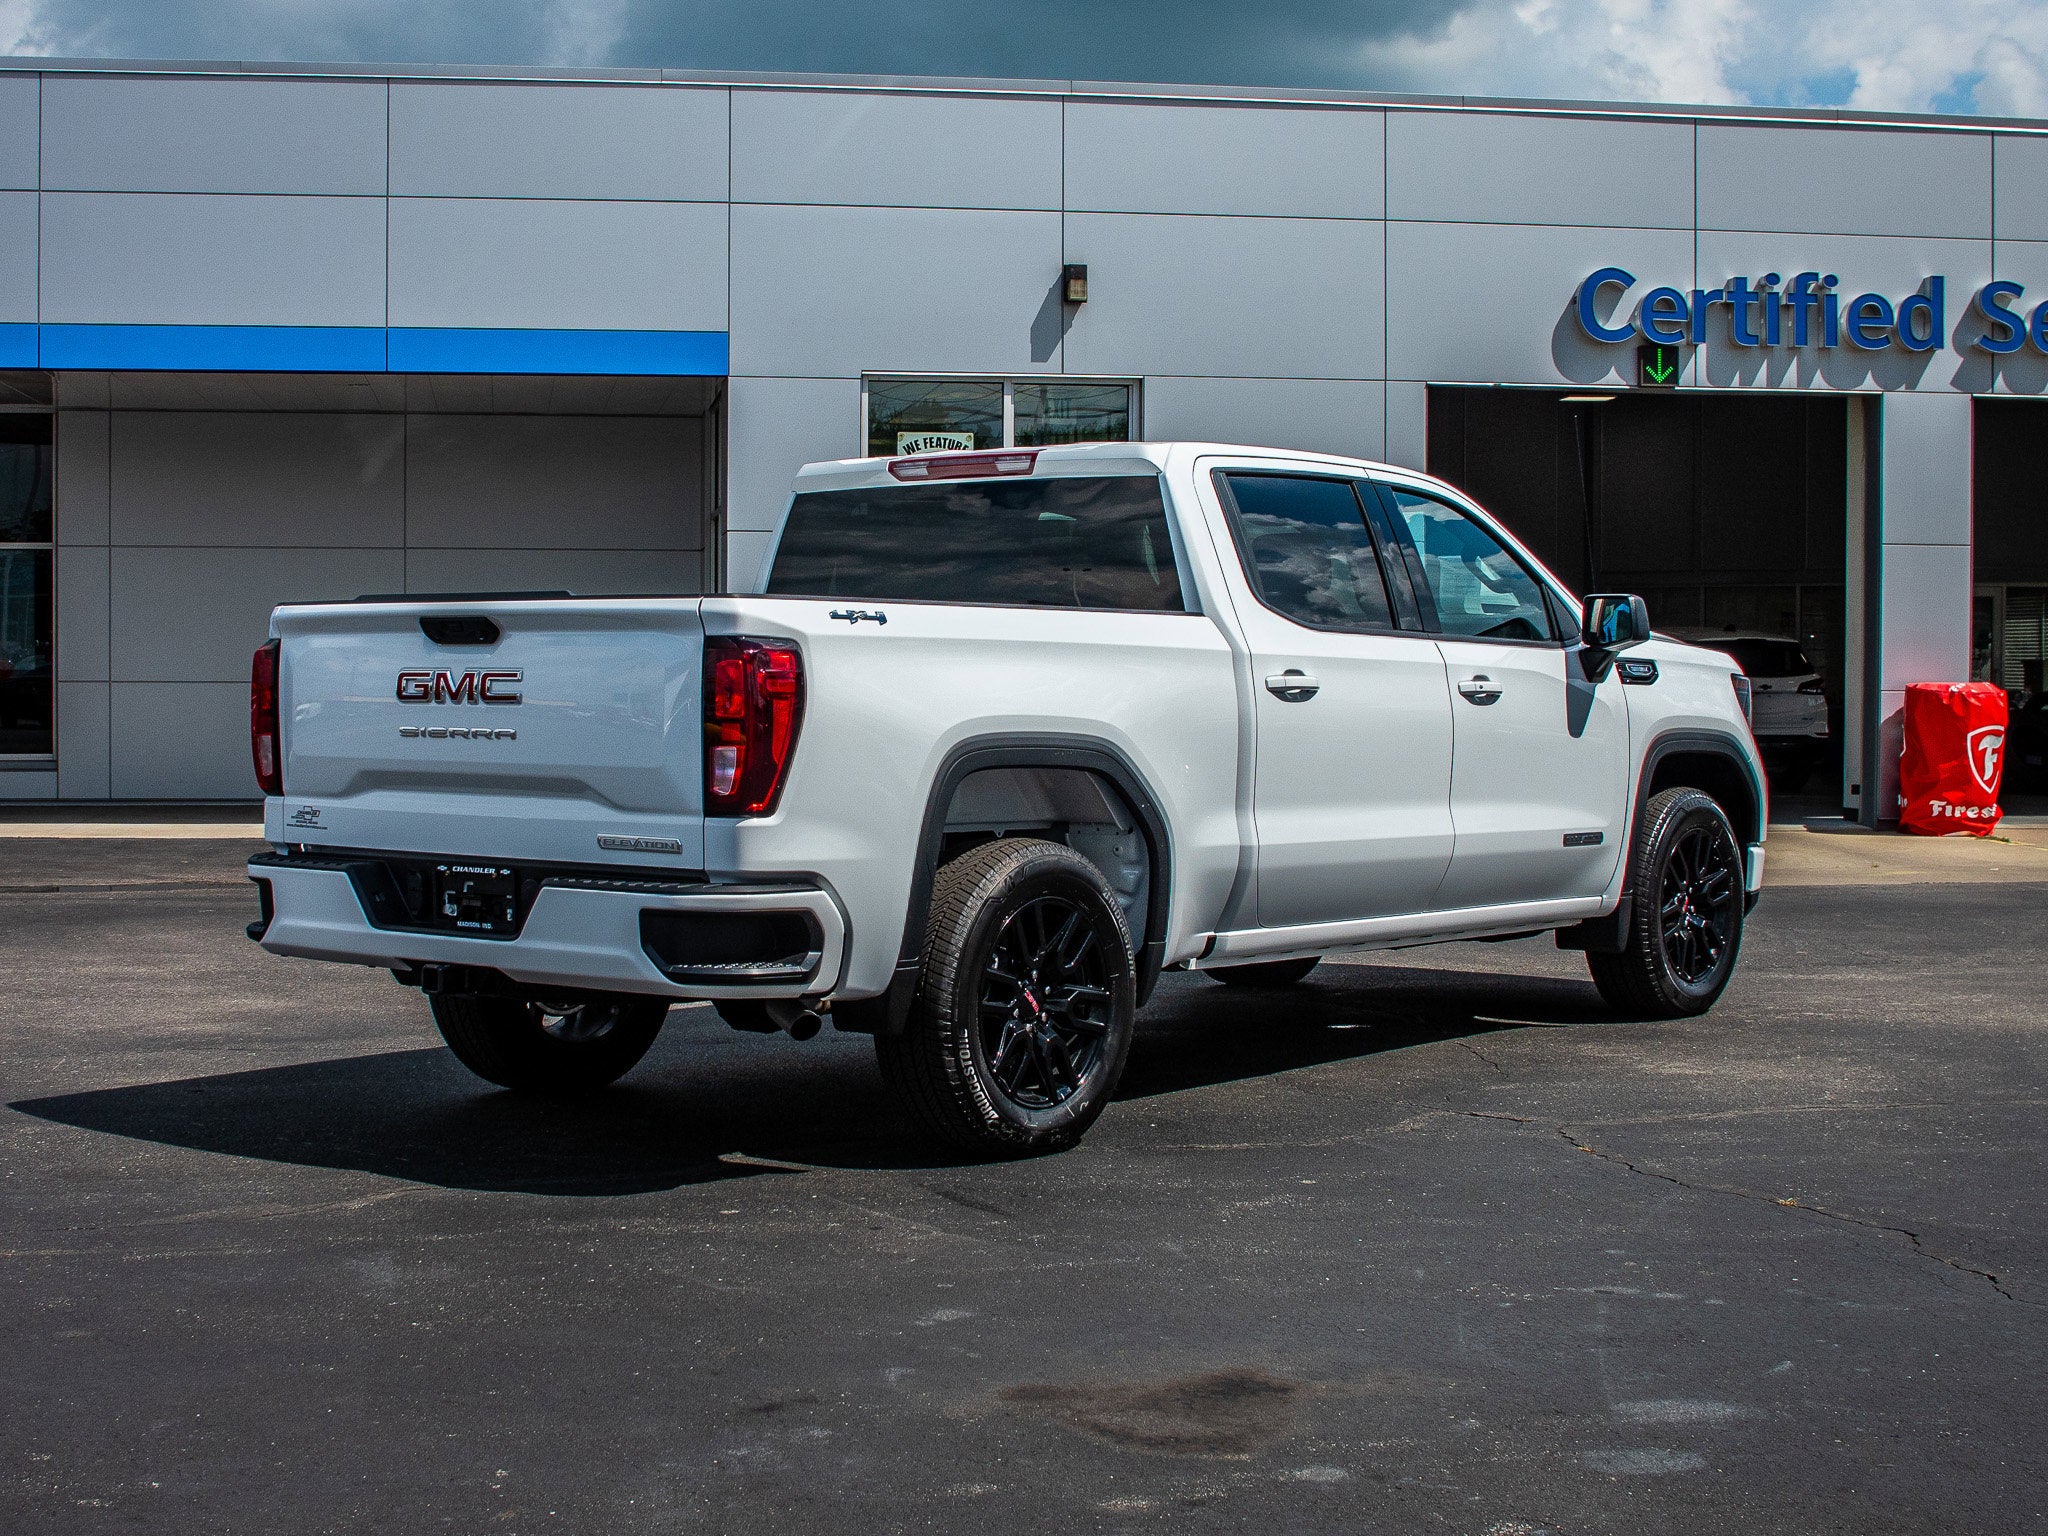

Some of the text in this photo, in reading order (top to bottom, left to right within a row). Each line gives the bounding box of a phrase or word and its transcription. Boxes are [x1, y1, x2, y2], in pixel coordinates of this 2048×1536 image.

[1577, 267, 1945, 351] Certified
[902, 439, 922, 455] WE
[396, 667, 523, 705] GMC
[399, 727, 517, 740] SIERRA
[1929, 800, 1997, 819] Fires
[602, 838, 676, 850] ELEVATION
[452, 865, 496, 874] CHANDLER
[959, 1028, 1000, 1121] BRIDGESTONE
